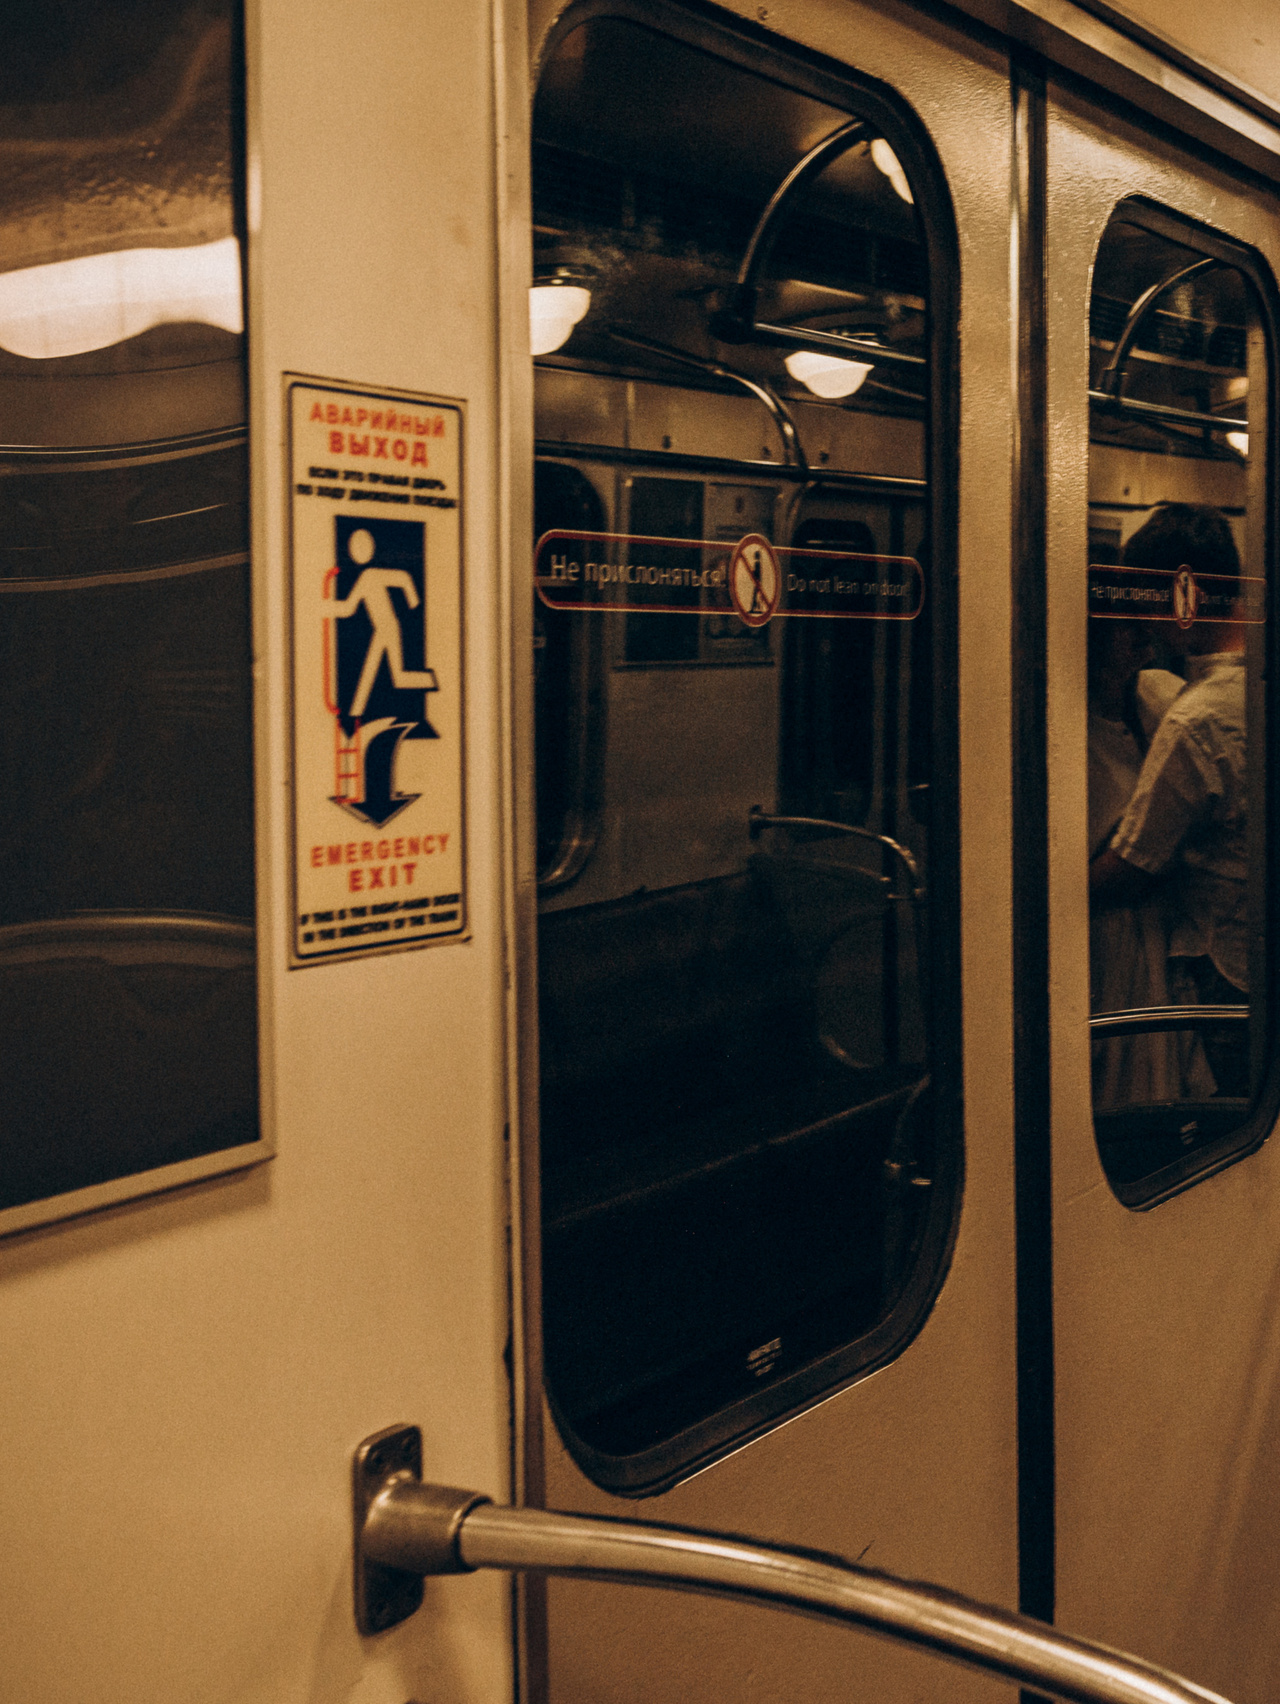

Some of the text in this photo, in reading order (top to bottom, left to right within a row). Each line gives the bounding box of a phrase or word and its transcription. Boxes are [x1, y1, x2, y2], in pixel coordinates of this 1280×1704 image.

[310, 402, 446, 438] АВАРИЙНЫЙ
[328, 431, 429, 468] ВЫХОД
[551, 554, 727, 590] Не прислоняться!
[787, 574, 807, 592] Do
[310, 833, 450, 868] EMERGENCY
[348, 862, 418, 893] EXIT
